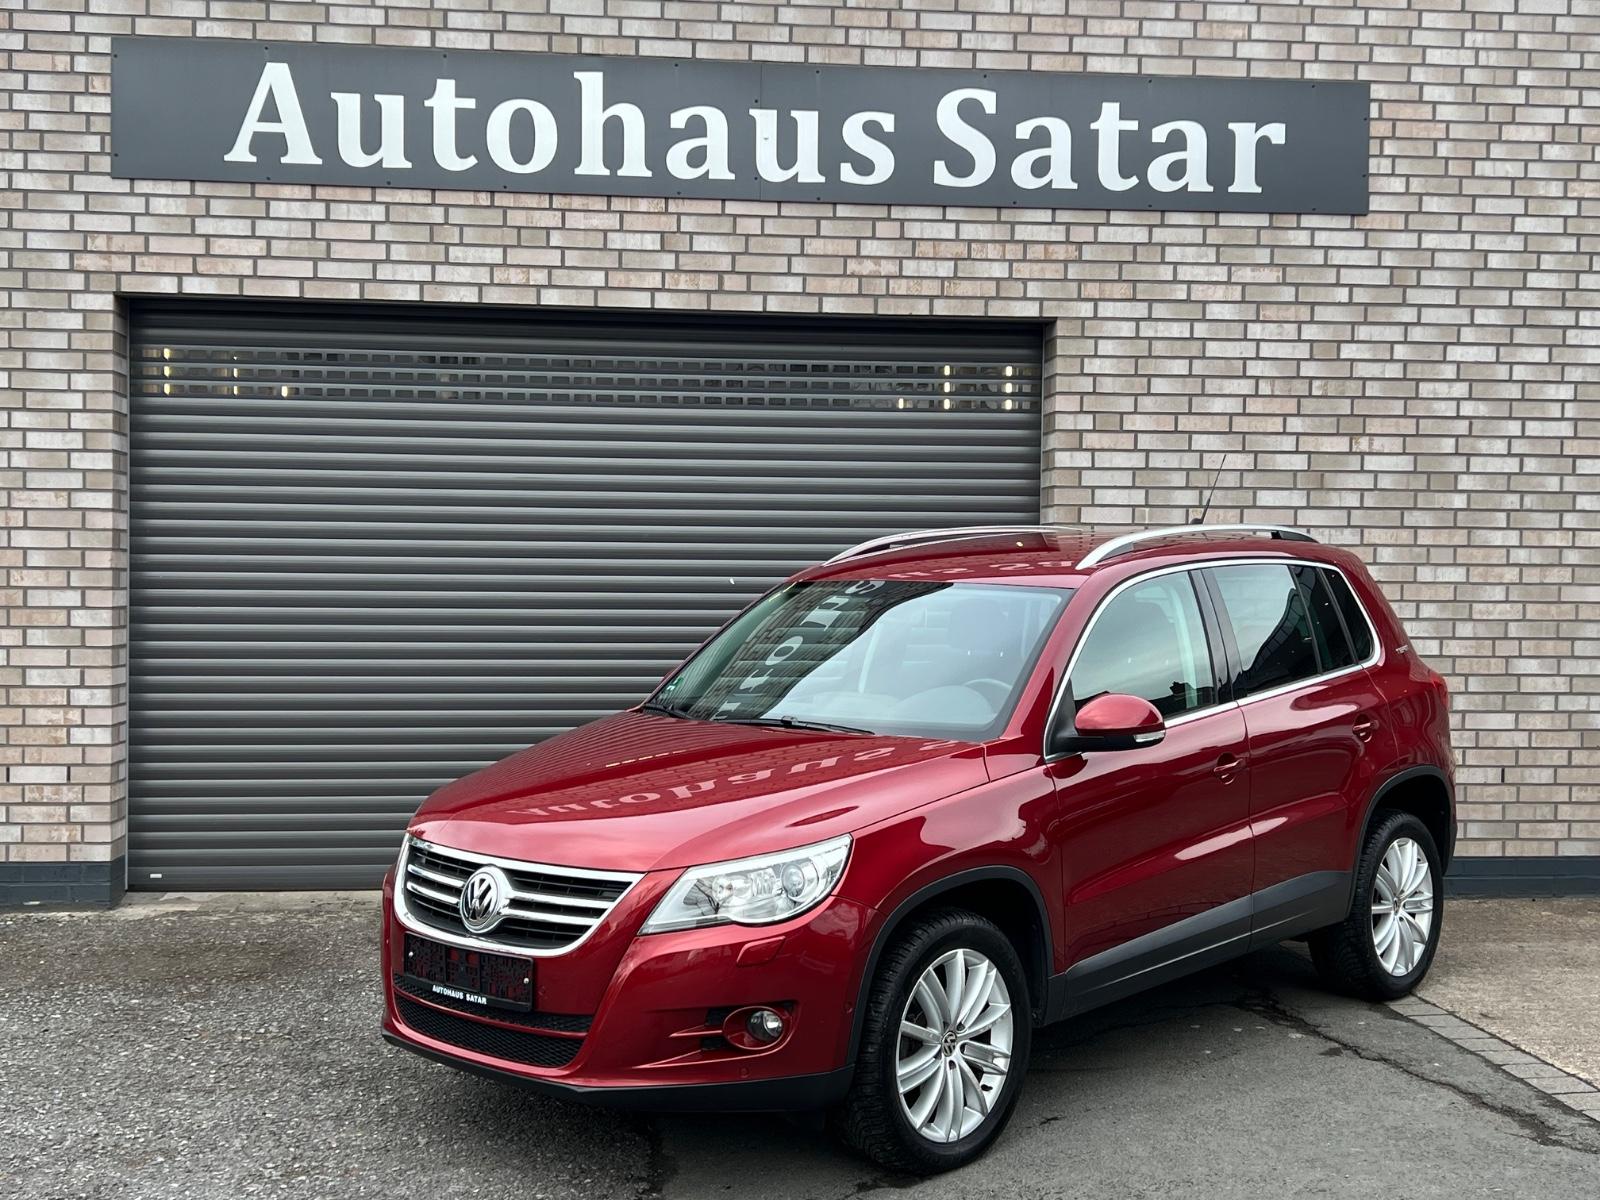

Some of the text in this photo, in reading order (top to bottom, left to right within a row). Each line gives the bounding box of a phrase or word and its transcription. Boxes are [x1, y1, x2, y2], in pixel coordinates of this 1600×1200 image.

[223, 61, 1287, 194] Autohaus Satar
[432, 984, 487, 1004] AUTOHAUS SATAR
